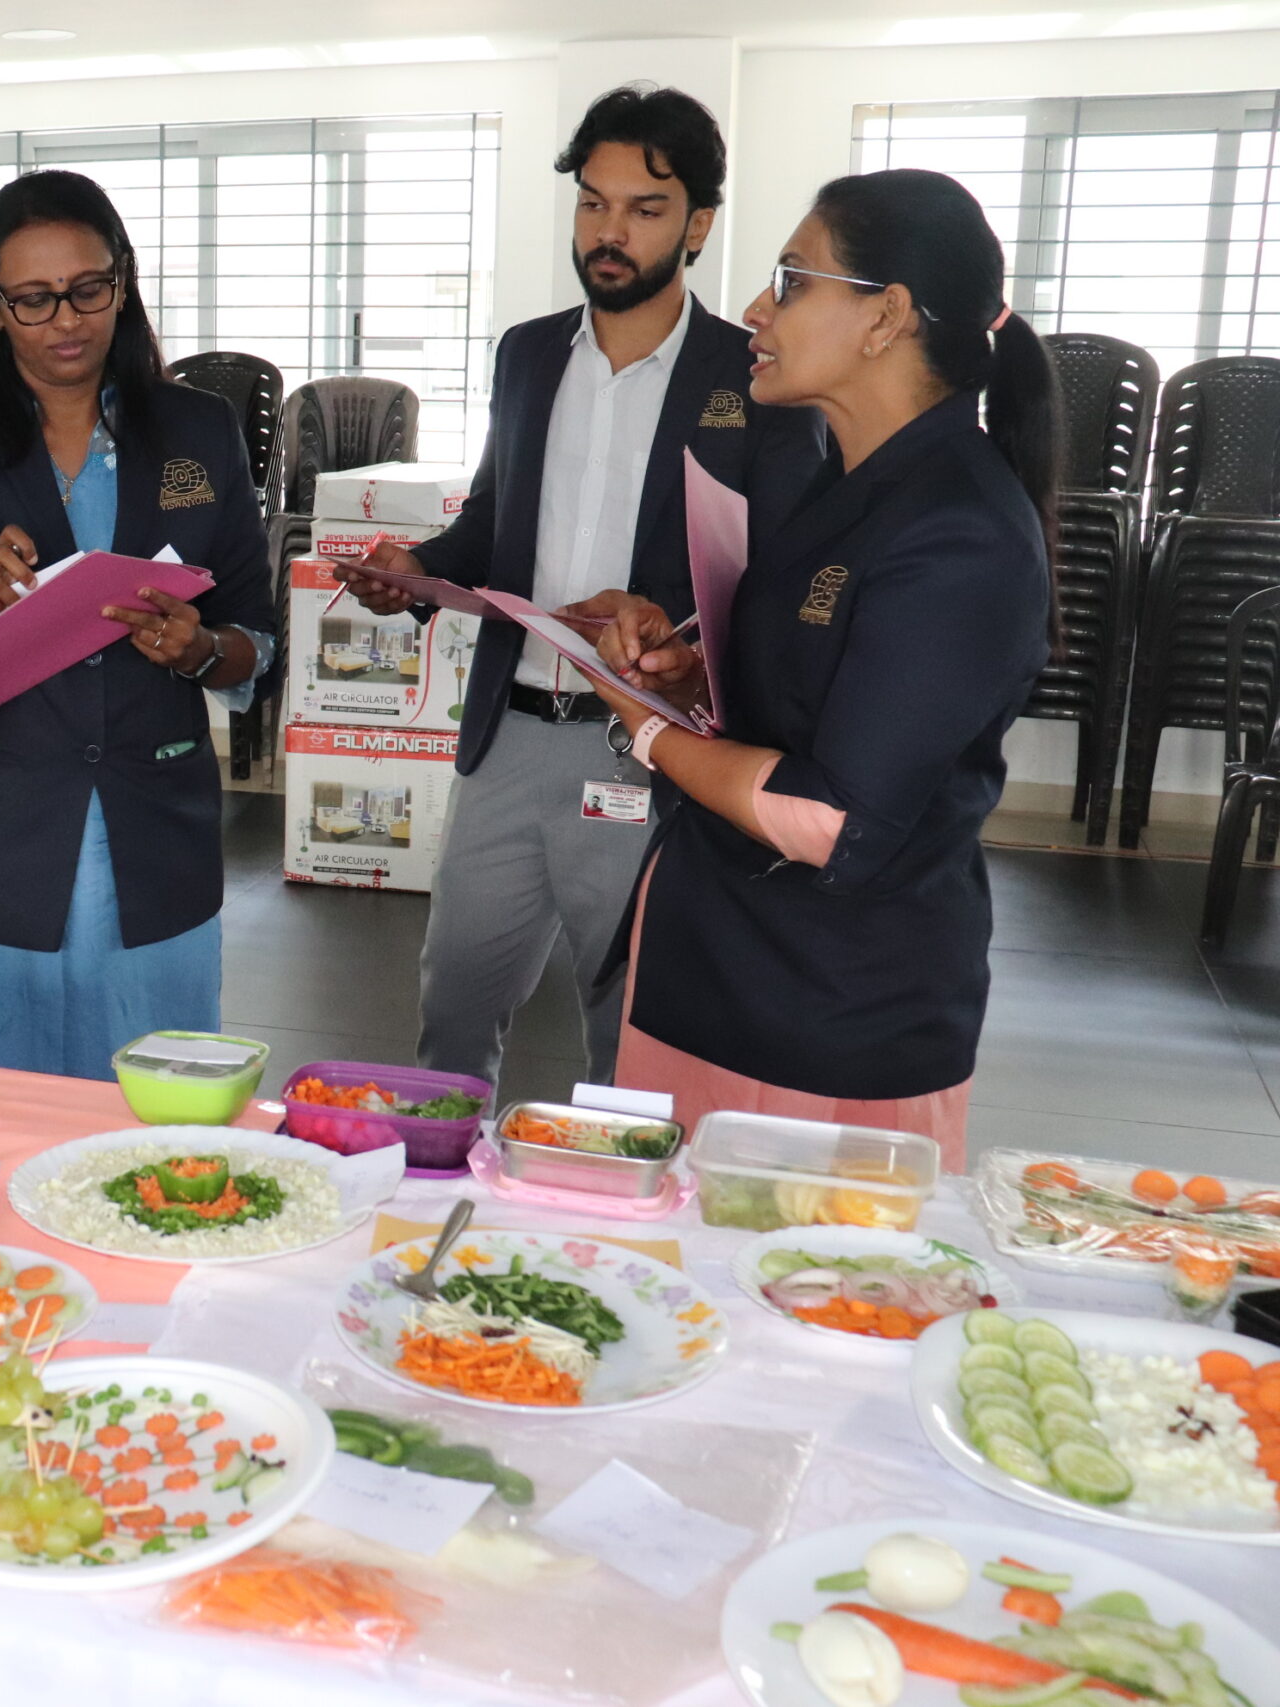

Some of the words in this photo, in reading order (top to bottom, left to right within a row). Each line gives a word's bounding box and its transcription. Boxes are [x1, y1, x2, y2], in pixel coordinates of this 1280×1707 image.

[323, 692, 338, 701] AIR
[340, 693, 399, 705] CIRCULATOR
[314, 854, 329, 863] AIR
[331, 855, 389, 867] CIRCULATOR
